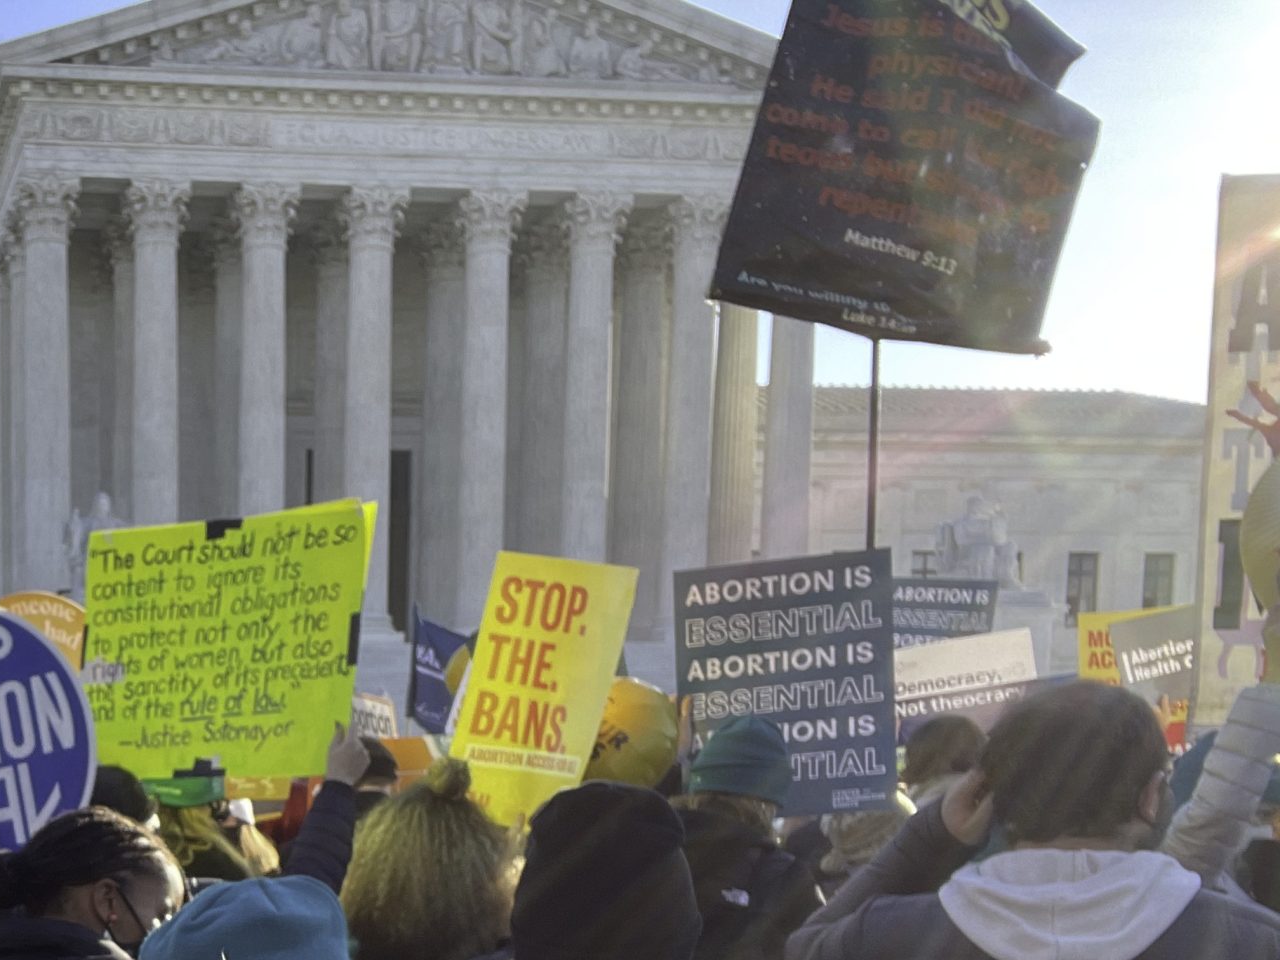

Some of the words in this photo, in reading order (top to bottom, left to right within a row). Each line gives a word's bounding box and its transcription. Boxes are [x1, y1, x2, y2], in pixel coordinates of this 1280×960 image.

[844, 227, 920, 263] Matthew
[921, 248, 958, 276] 9:13
[141, 540, 194, 566] Court
[196, 528, 256, 565] should
[261, 524, 300, 557] not
[303, 523, 328, 550] be
[332, 524, 358, 546] so
[91, 569, 165, 601] content
[173, 568, 197, 592] to
[206, 564, 265, 598] ignore
[274, 556, 302, 581] its
[685, 567, 835, 608] ABORTION
[844, 565, 873, 589] IS
[893, 585, 973, 604] ABORTION
[976, 588, 990, 606] IS
[92, 594, 222, 628] constitutional
[230, 582, 342, 622] obligations
[494, 576, 589, 636] STOP.
[685, 599, 883, 649] ESSENTIAL
[93, 634, 113, 655] to
[117, 624, 187, 661] protect
[194, 619, 231, 645] not
[236, 618, 280, 650] only
[290, 608, 329, 636] the
[91, 656, 141, 685] rights
[148, 648, 170, 671] of
[250, 641, 288, 664] but
[292, 634, 334, 660] also
[488, 633, 558, 692] THE.
[687, 645, 836, 682] ABORTION
[847, 641, 874, 665] IS
[1133, 660, 1181, 682] Health
[122, 699, 143, 720] of
[145, 697, 174, 720] the
[180, 689, 218, 716] rule
[224, 688, 248, 713] of
[123, 673, 203, 703] sanctity
[212, 665, 234, 690] of
[693, 674, 885, 721] ESSENTIAL
[896, 668, 1003, 697] Democracy,
[469, 691, 568, 754] BANS.
[895, 701, 928, 718] Not
[692, 717, 837, 754] AION
[848, 715, 876, 737] IS
